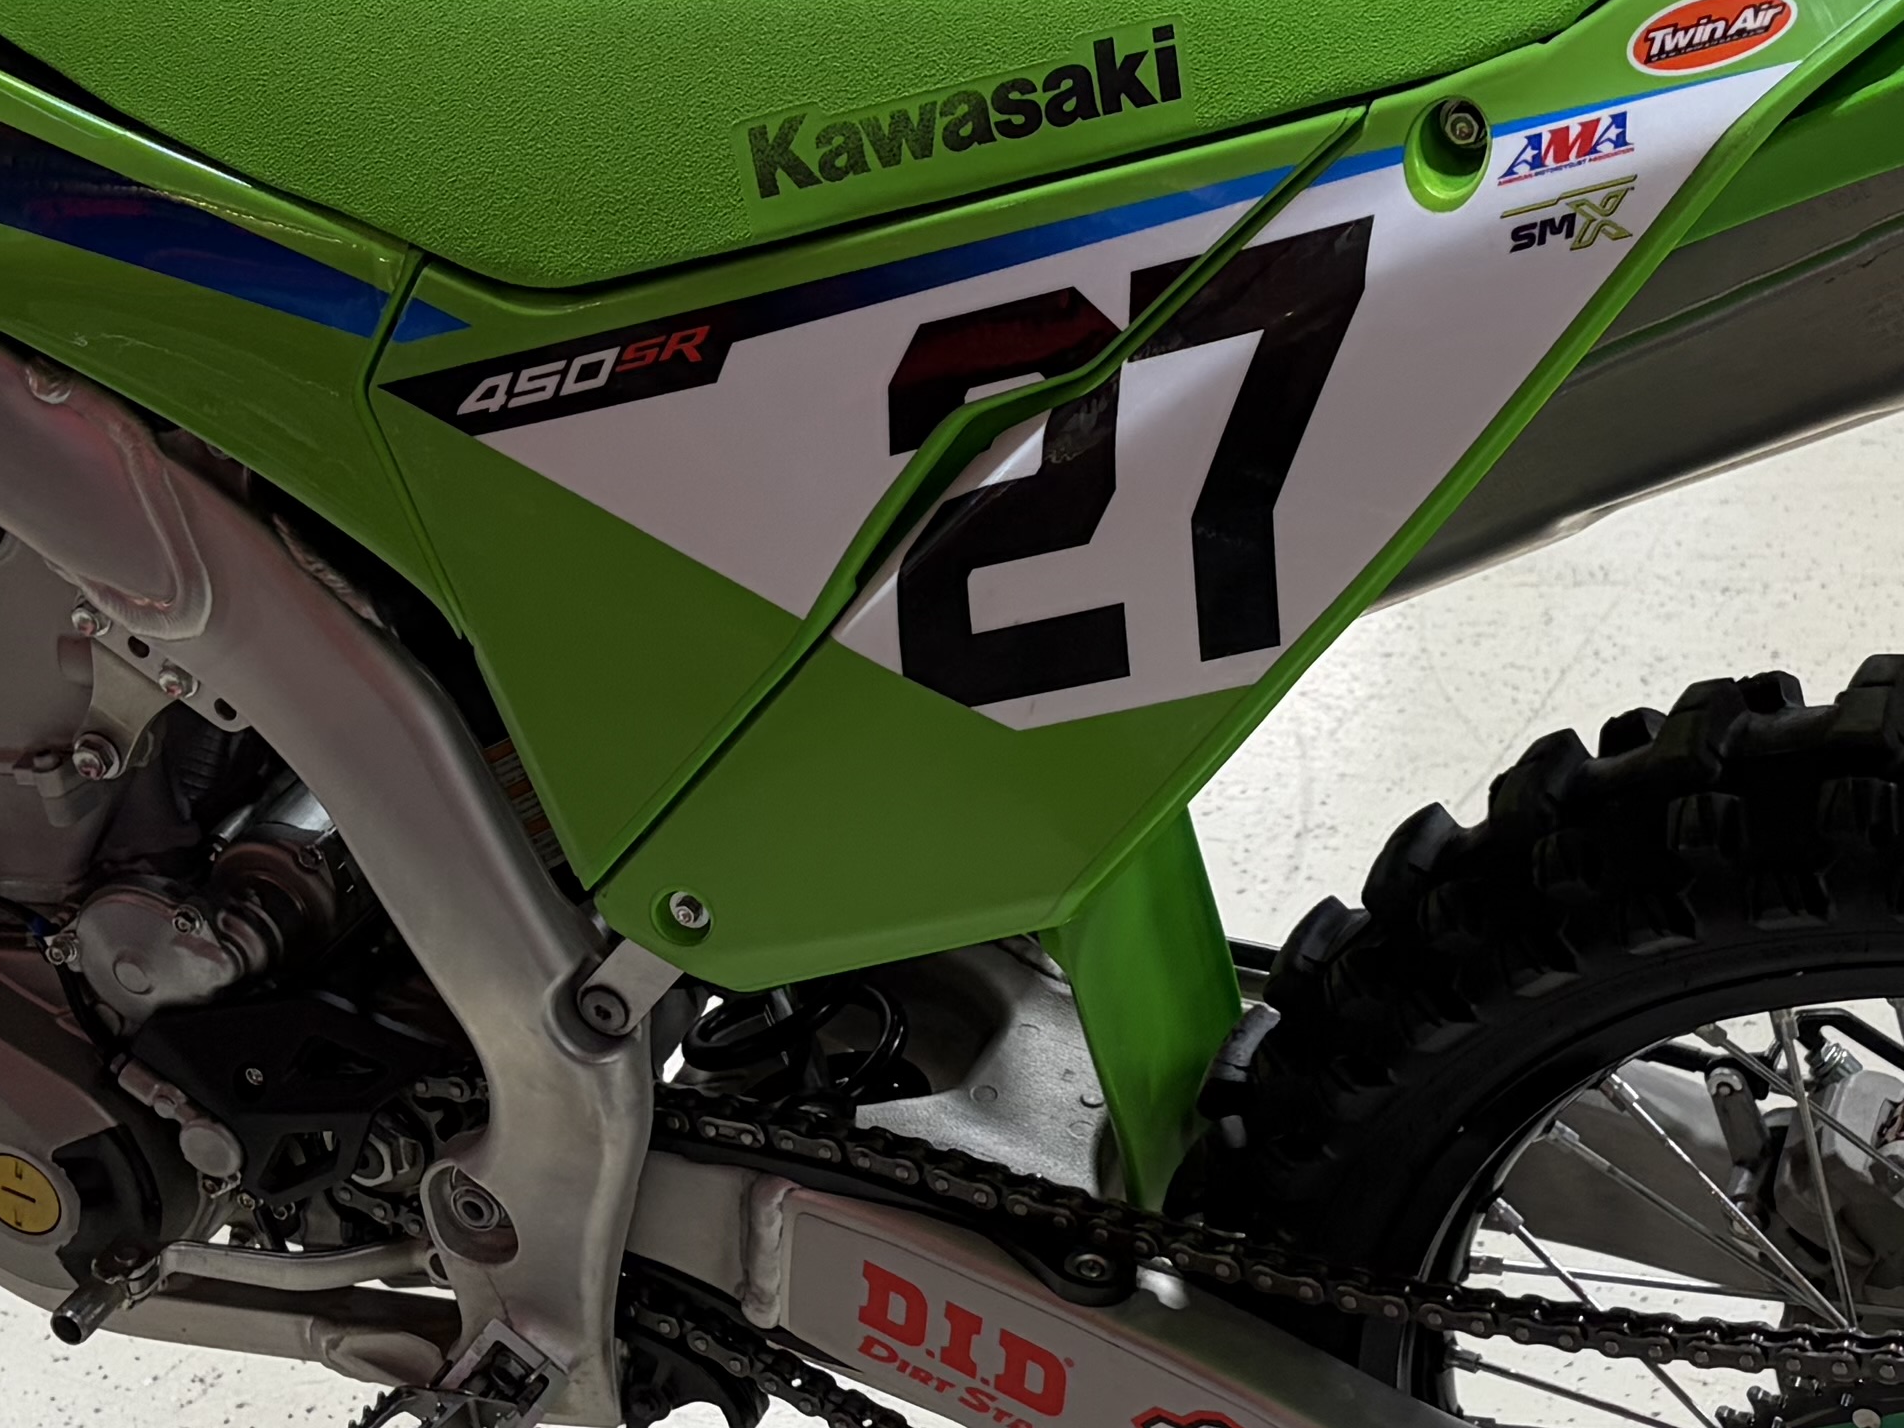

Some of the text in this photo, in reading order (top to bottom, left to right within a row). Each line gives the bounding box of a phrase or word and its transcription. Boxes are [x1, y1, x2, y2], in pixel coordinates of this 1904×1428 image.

[1648, 18, 1726, 56] Twin
[1727, 3, 1784, 36] Air
[747, 23, 1183, 200] Kawasaki
[1497, 111, 1634, 180] AMA
[1509, 187, 1634, 253] SMX
[888, 215, 1374, 708] 27
[857, 1335, 956, 1394] DIRT
[858, 1260, 1068, 1418] D.I.D
